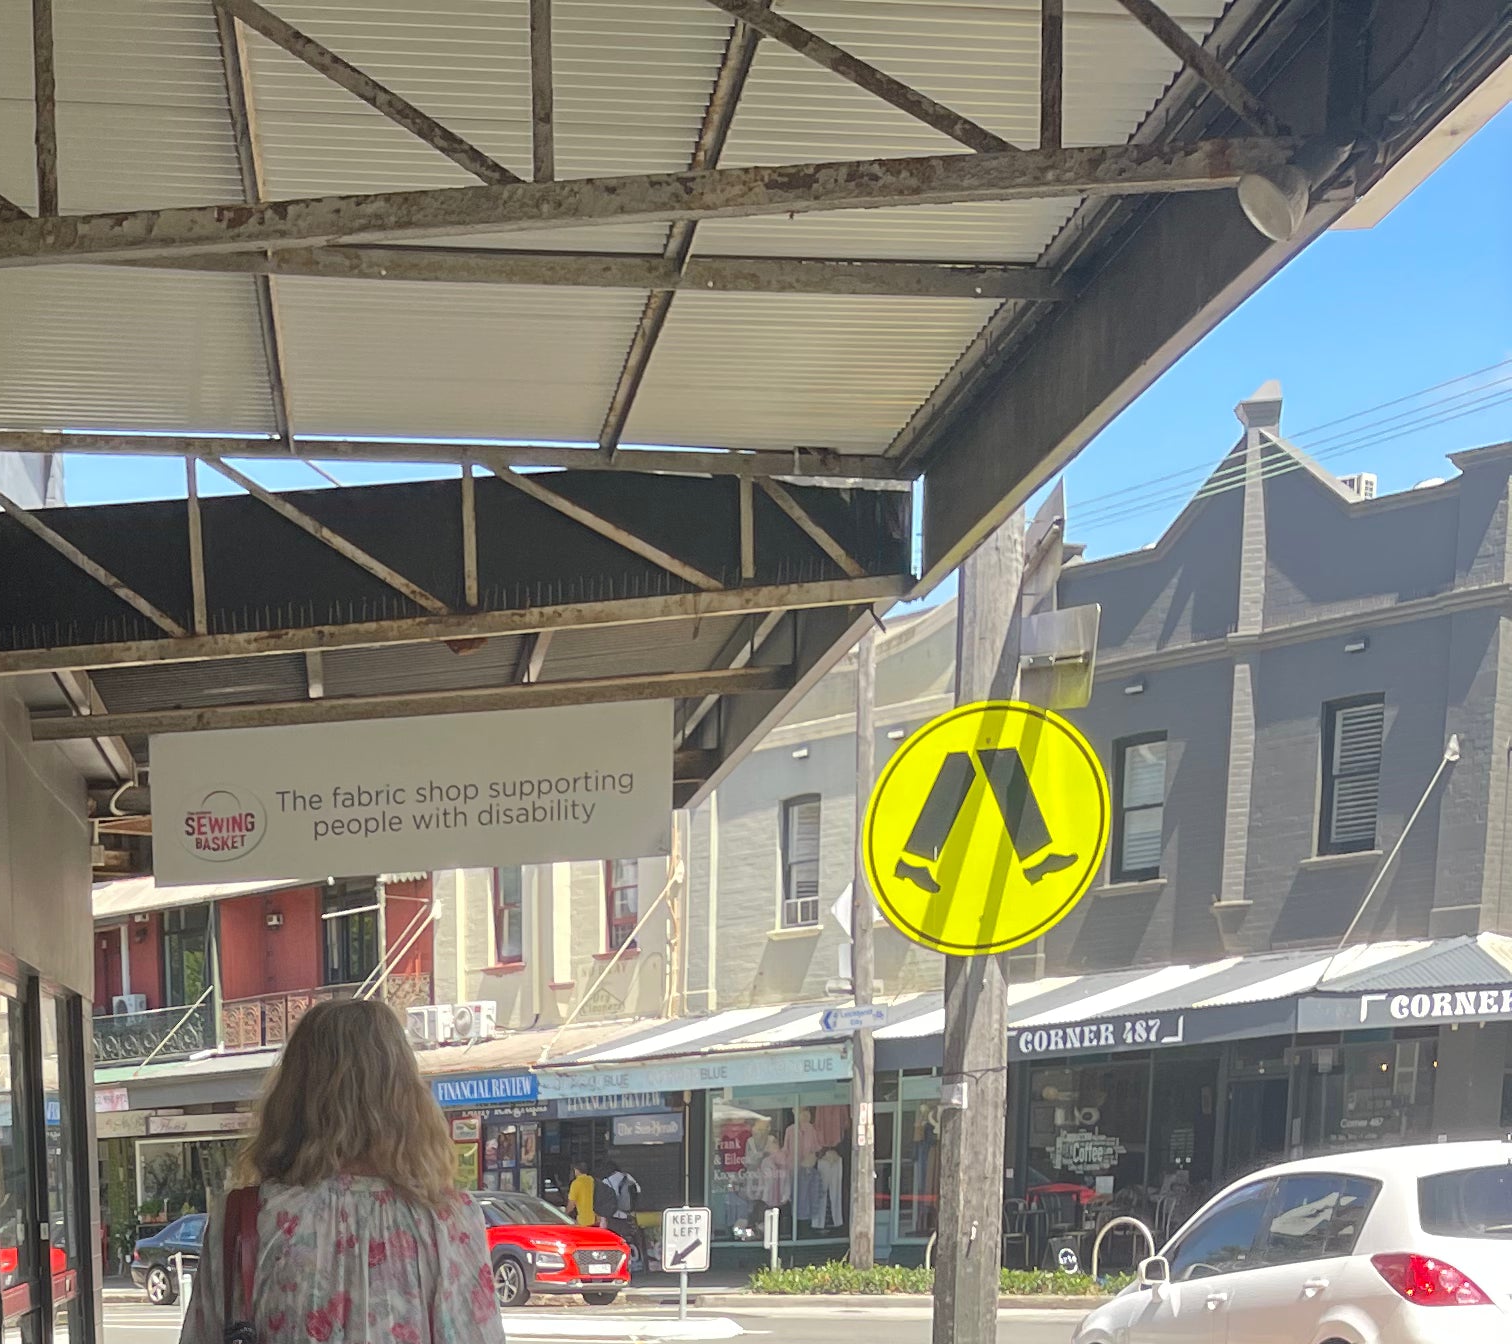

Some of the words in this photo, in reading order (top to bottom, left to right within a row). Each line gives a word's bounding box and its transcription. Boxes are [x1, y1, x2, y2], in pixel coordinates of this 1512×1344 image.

[276, 789, 322, 813] The
[333, 781, 406, 808] fabric
[415, 780, 479, 807] shop
[489, 769, 634, 801] supporting
[185, 813, 255, 836] SEWING
[313, 814, 403, 841] people
[412, 806, 468, 831] with
[478, 799, 596, 830] disability
[196, 835, 246, 851] BASKET
[1018, 1022, 1115, 1054] CORNER
[1122, 1018, 1161, 1044] 487
[700, 1066, 728, 1080] BLUE
[803, 1058, 833, 1073] BLUE
[437, 1079, 492, 1102] FINANCIAL
[492, 1076, 532, 1099] REVIEW
[714, 1137, 741, 1150] Frank
[1072, 1141, 1104, 1164] Coffee
[672, 1214, 702, 1225] KEEP
[673, 1226, 700, 1238] LEFT
